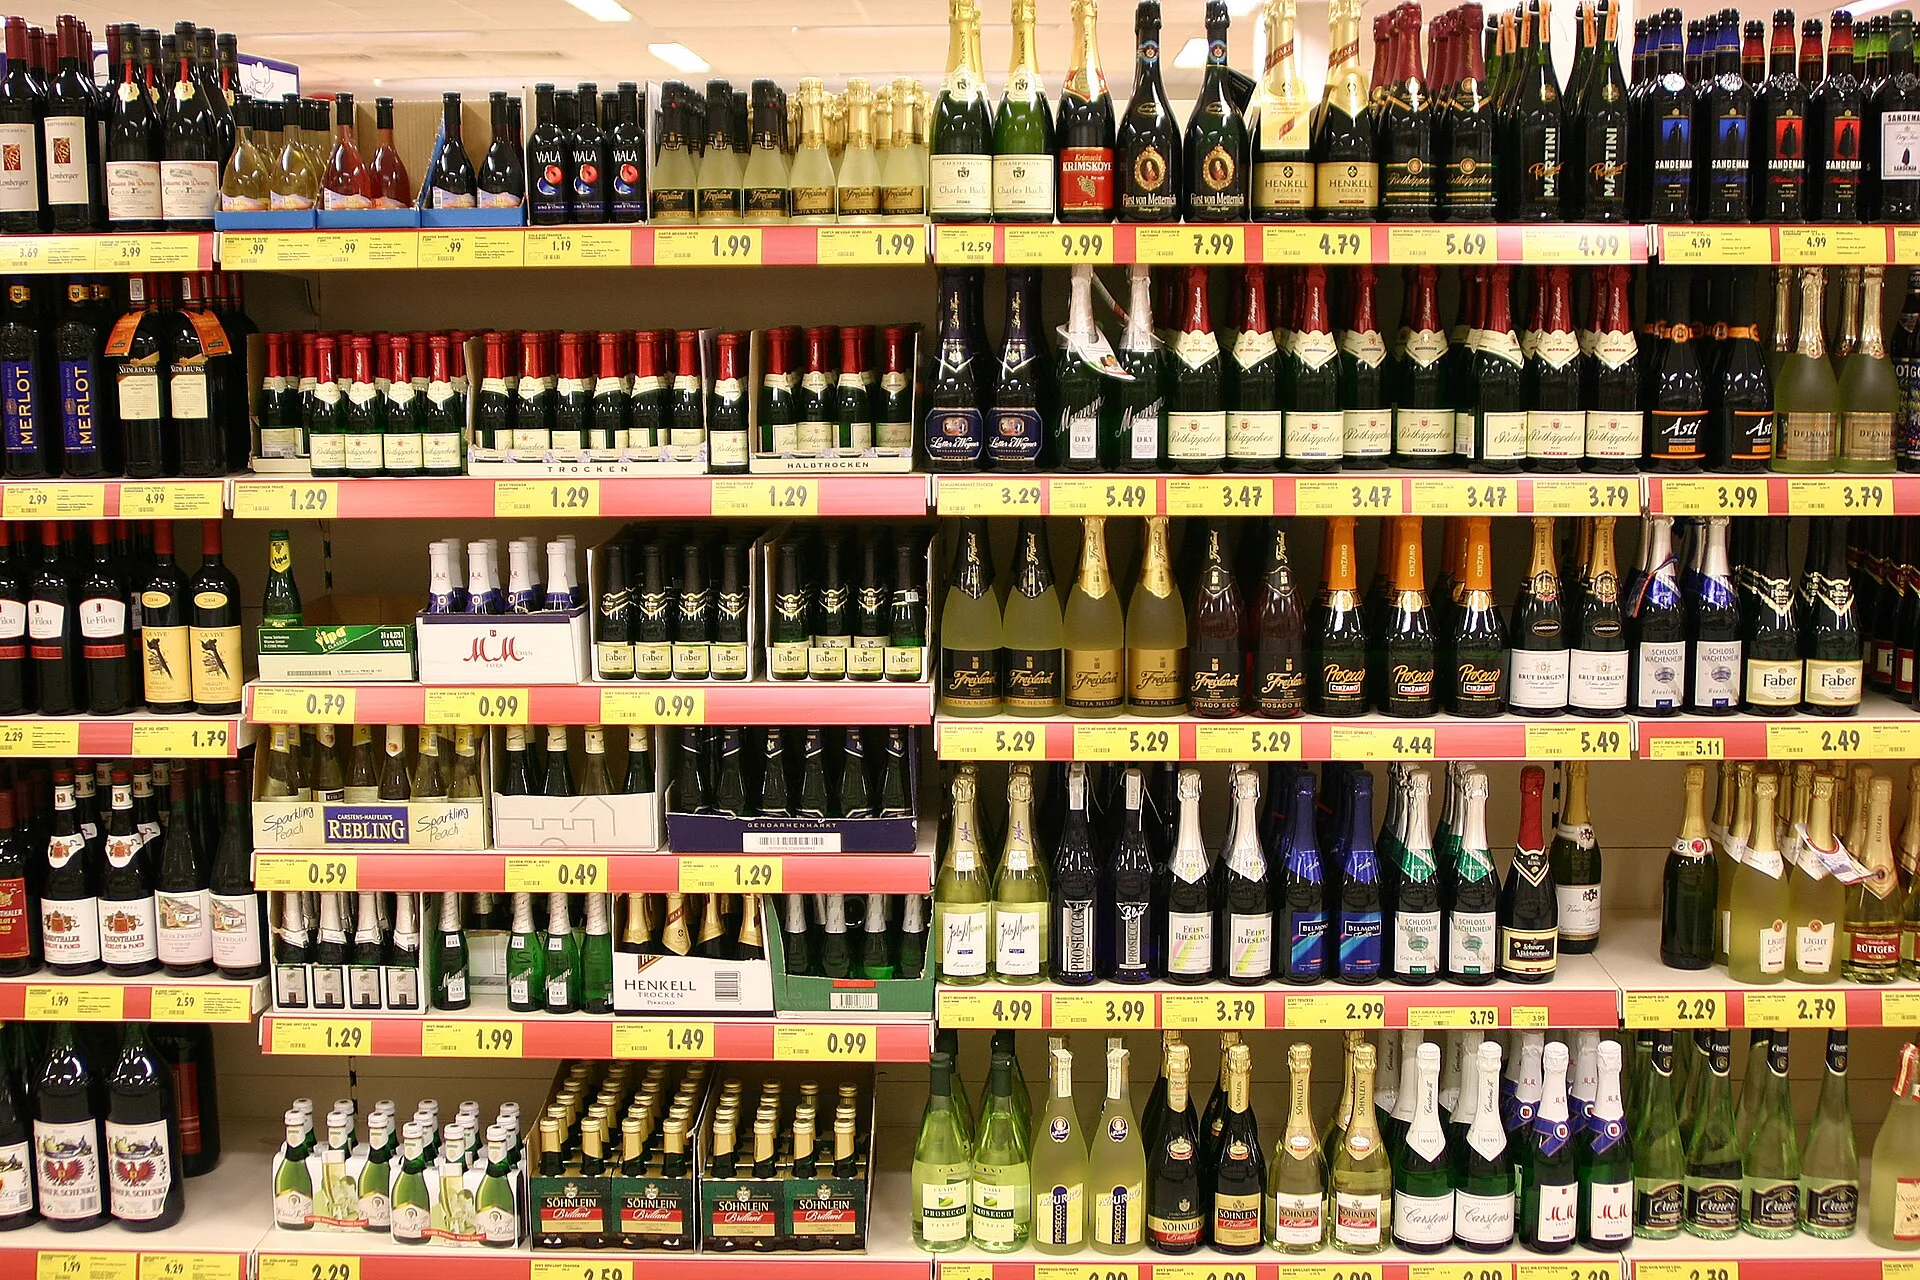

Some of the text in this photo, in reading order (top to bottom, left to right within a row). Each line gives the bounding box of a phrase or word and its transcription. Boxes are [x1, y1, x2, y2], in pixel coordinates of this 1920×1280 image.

[536, 151, 561, 163] VIALA
[572, 151, 597, 162] VIALA
[613, 150, 638, 162] VIALA
[1544, 127, 1556, 197] MARTINI
[1603, 127, 1617, 197] MARTINI
[1265, 180, 1308, 189] HENKELL
[1329, 180, 1373, 189] HENKELL
[20, 248, 38, 258] 3.69
[122, 247, 141, 257] 3.99
[552, 241, 571, 251] 1.19
[712, 235, 751, 257] 1.99
[875, 234, 914, 256] 1.99
[961, 241, 992, 253] 12.59
[1061, 234, 1103, 256] 9.99
[1193, 233, 1233, 255] 7.99
[1319, 234, 1361, 255] 4.79
[1446, 233, 1486, 255] 5.69
[1579, 234, 1619, 255] 4.99
[1691, 238, 1711, 248] 4.99
[1806, 238, 1826, 248] 4.99
[16, 366, 34, 445] MERLOT
[74, 366, 92, 445] MERLOT
[1661, 417, 1702, 437] Asti
[29, 495, 47, 505] 2.99
[146, 494, 165, 504] 4.99
[290, 489, 327, 510] 1.29
[551, 486, 589, 508] 1.29
[769, 486, 807, 507] 1.29
[1002, 487, 1040, 504] 3.29
[1106, 486, 1146, 507] 5.49
[1223, 486, 1262, 507] 3.47
[1352, 486, 1391, 507] 3.47
[1467, 486, 1506, 507] 3.47
[1589, 486, 1628, 507] 3.79
[1718, 486, 1757, 508] 3.99
[1843, 486, 1883, 508] 3.79
[605, 653, 626, 661] Faber
[642, 653, 664, 661] Faber
[680, 653, 701, 661] Faber
[1518, 673, 1535, 681] BRUT
[1763, 674, 1797, 686] Faber
[1821, 674, 1856, 686] Faber
[306, 694, 345, 715] 0.79
[479, 696, 517, 716] 0.99
[655, 695, 694, 716] 0.99
[5, 732, 23, 742] 2.29
[192, 730, 226, 747] 1.79
[996, 731, 1035, 752] 5.29
[1130, 731, 1168, 752] 5.29
[1252, 731, 1290, 752] 5.29
[1393, 737, 1432, 753] 4.44
[1581, 731, 1620, 753] 5.49
[1821, 730, 1860, 751] 2.49
[1696, 740, 1720, 755] 5.11
[263, 807, 314, 832] Sparkling
[328, 820, 405, 839] REBLING
[416, 808, 469, 833] Sparkling
[275, 823, 303, 842] Peach
[429, 822, 459, 842] Peach
[308, 863, 347, 884] 0.59
[558, 864, 597, 885] 0.49
[734, 864, 772, 885] 1.29
[1183, 925, 1204, 933] FEIST
[1803, 937, 1827, 945] LIGHT
[1856, 942, 1896, 954] RÜTTGERS
[625, 980, 697, 991] HENKELL
[51, 997, 69, 1006] 1.99
[176, 997, 195, 1007] 2.59
[992, 1000, 1032, 1021] 4.99
[1106, 1001, 1144, 1022] 3.99
[1216, 1000, 1255, 1021] 3.79
[1346, 1003, 1384, 1019] 2.99
[1677, 999, 1716, 1019] 2.29
[1798, 999, 1836, 1019] 2.79
[1470, 1011, 1495, 1025] 3.79
[325, 1028, 362, 1048] 1.29
[476, 1029, 512, 1050] 1.99
[667, 1029, 704, 1050] 1.49
[827, 1033, 866, 1054] 0.99
[547, 1197, 596, 1208] SÖHNLEIN
[627, 1197, 676, 1209] SÖHNLEIN
[719, 1200, 769, 1211] SÖHNLEIN
[799, 1199, 850, 1210] SÖHNLEIN
[925, 1207, 964, 1217] PROSECCO
[1219, 1209, 1257, 1219] SÖHNLEIN
[63, 1262, 81, 1272] 1.99
[164, 1264, 183, 1274] 4.29
